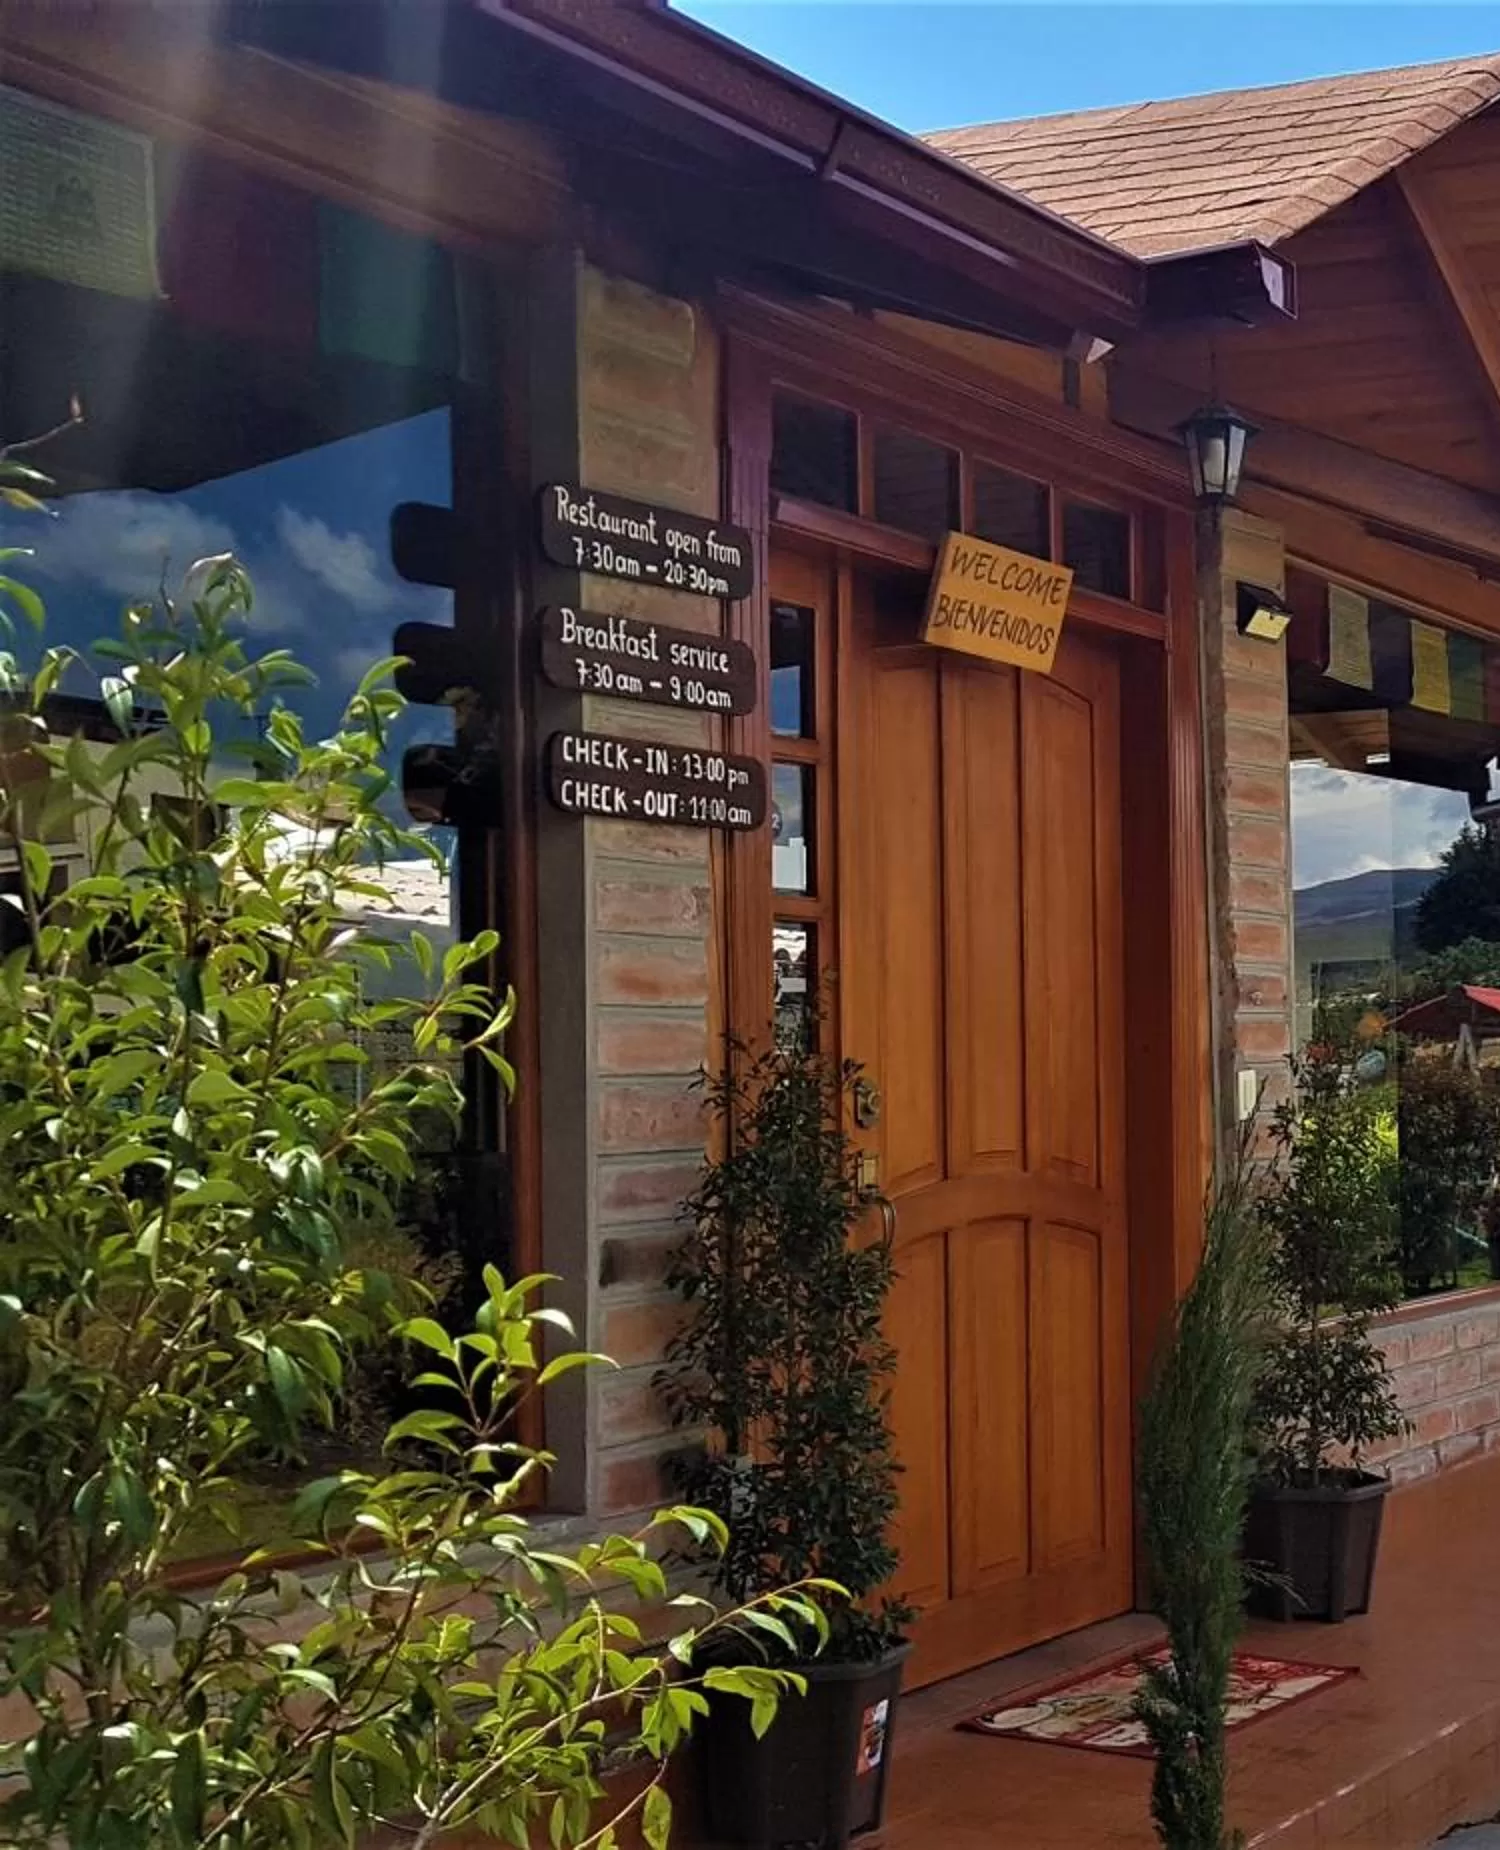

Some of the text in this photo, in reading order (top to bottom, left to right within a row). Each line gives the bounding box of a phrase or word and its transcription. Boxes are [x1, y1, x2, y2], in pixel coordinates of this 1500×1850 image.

[554, 485, 741, 569] Restaurant open from
[951, 546, 1067, 606] WELCOME
[560, 607, 729, 673] Breakfast service
[933, 594, 1055, 654] BIENVENIDOS
